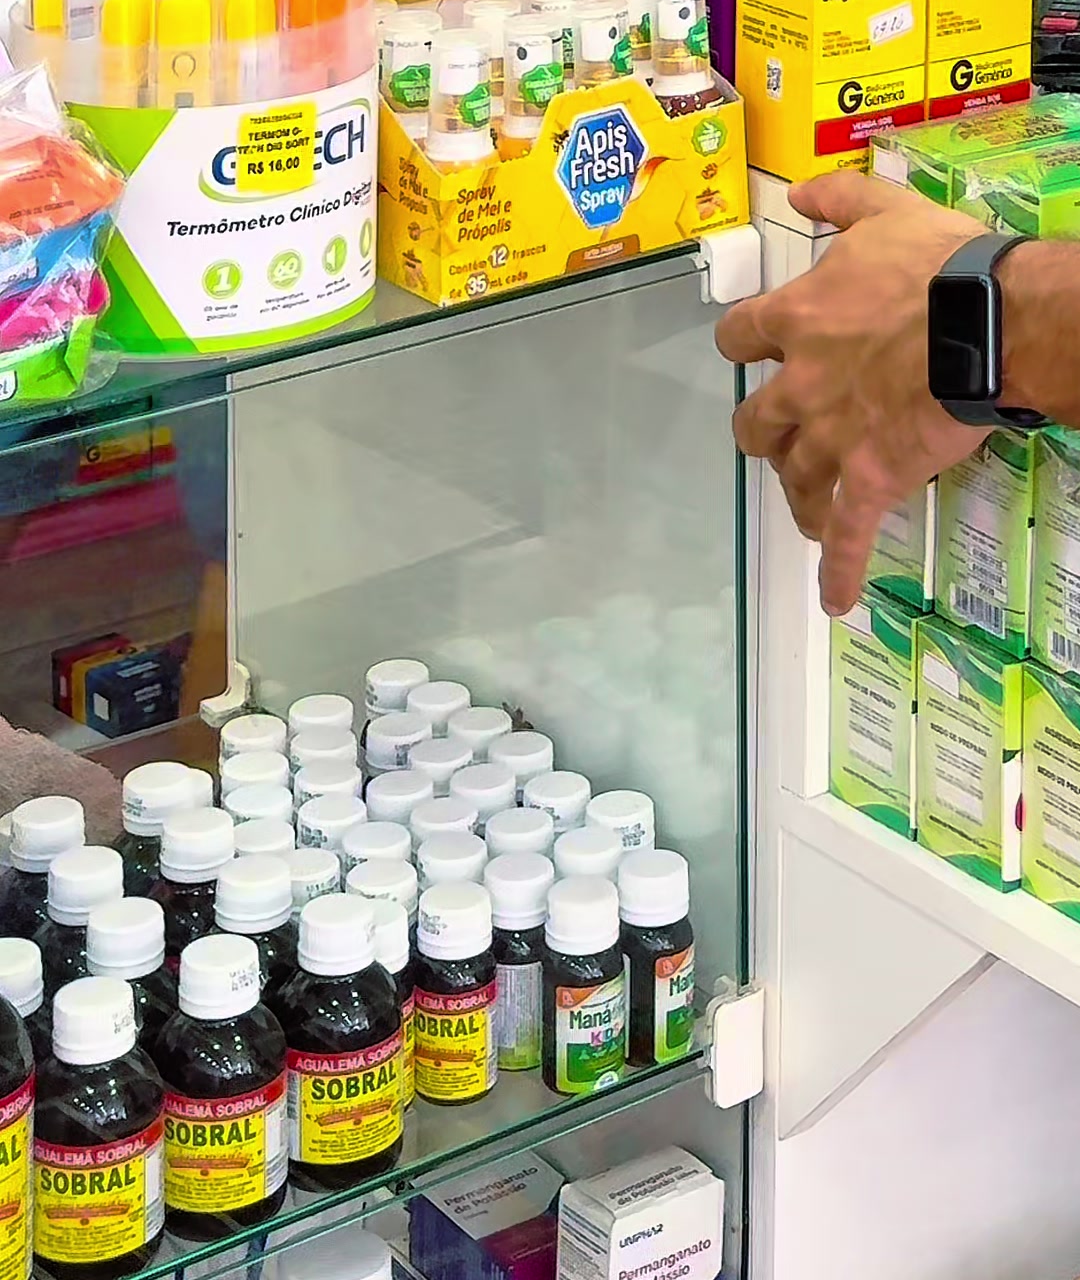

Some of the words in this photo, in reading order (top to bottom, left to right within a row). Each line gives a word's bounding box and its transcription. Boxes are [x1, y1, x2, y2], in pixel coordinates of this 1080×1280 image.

[950, 59, 974, 91] G
[837, 80, 864, 115] G
[574, 121, 628, 159] Apis
[247, 161, 265, 175] R$
[267, 156, 301, 173] 16,00
[569, 148, 636, 190] Fresh
[456, 183, 497, 209] Spray
[579, 184, 627, 213] Spray
[166, 213, 285, 237] Termômetro
[289, 197, 341, 223] Clínico
[457, 204, 476, 224] de
[478, 201, 502, 220] Mel
[502, 200, 512, 214] e
[457, 219, 512, 244] Própolis
[489, 244, 508, 267] 12
[467, 274, 488, 295] 35
[569, 1004, 612, 1030] Maná
[310, 1059, 397, 1101] SOBRAL
[213, 1095, 267, 1117] SOBRAL
[164, 1117, 257, 1148] SOBRAL
[96, 1138, 148, 1165] SOBRAL
[40, 1164, 137, 1196] SOBRAL
[444, 1165, 539, 1208] Permanganato
[608, 1163, 685, 1200] Permanganato
[453, 1202, 471, 1215] de
[471, 1181, 527, 1209] Potássio
[616, 1195, 631, 1206] de
[617, 1237, 712, 1280] Permanganato
